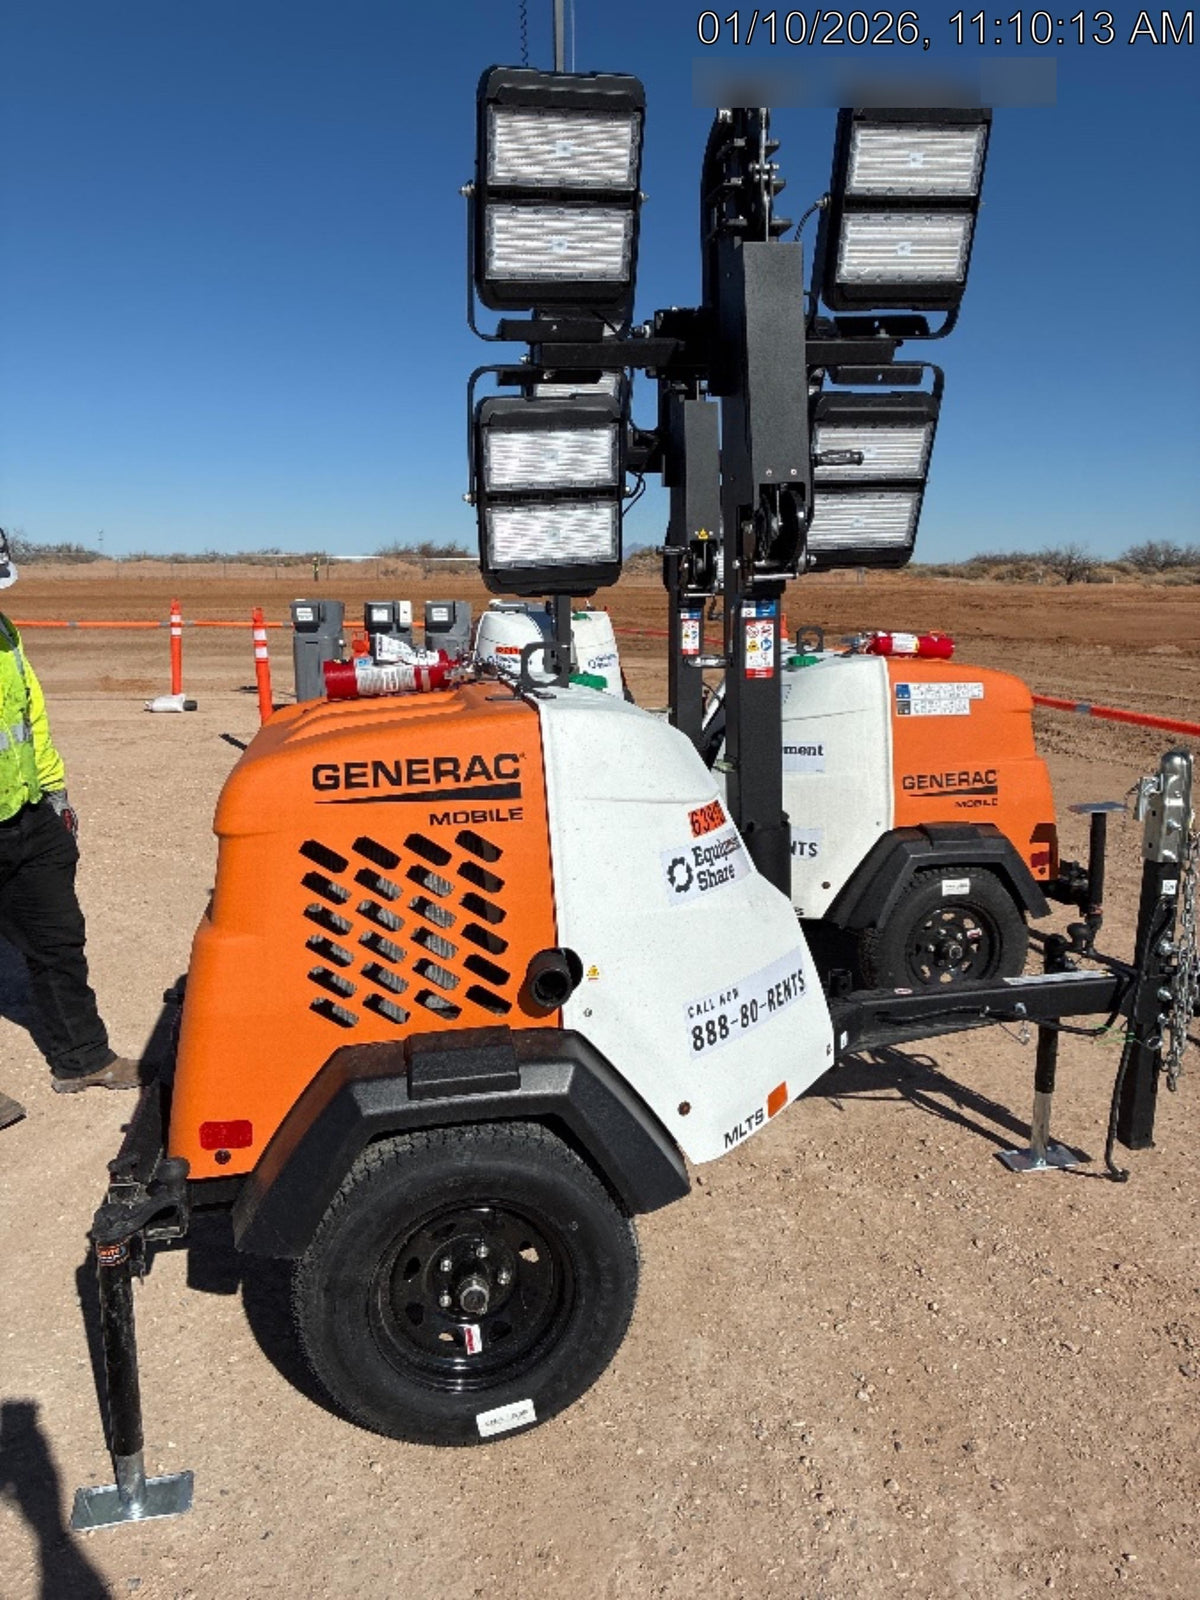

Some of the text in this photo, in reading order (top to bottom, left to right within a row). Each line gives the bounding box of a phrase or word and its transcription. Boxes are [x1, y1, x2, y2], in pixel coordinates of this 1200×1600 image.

[312, 753, 520, 791] GENERAC
[902, 769, 997, 790] GENERAC
[429, 807, 523, 826] MOBILE
[696, 864, 735, 892] Share
[687, 998, 715, 1019] CALL
[691, 968, 806, 1051] 888-80-RENTS
[723, 1107, 765, 1149] MLTS
